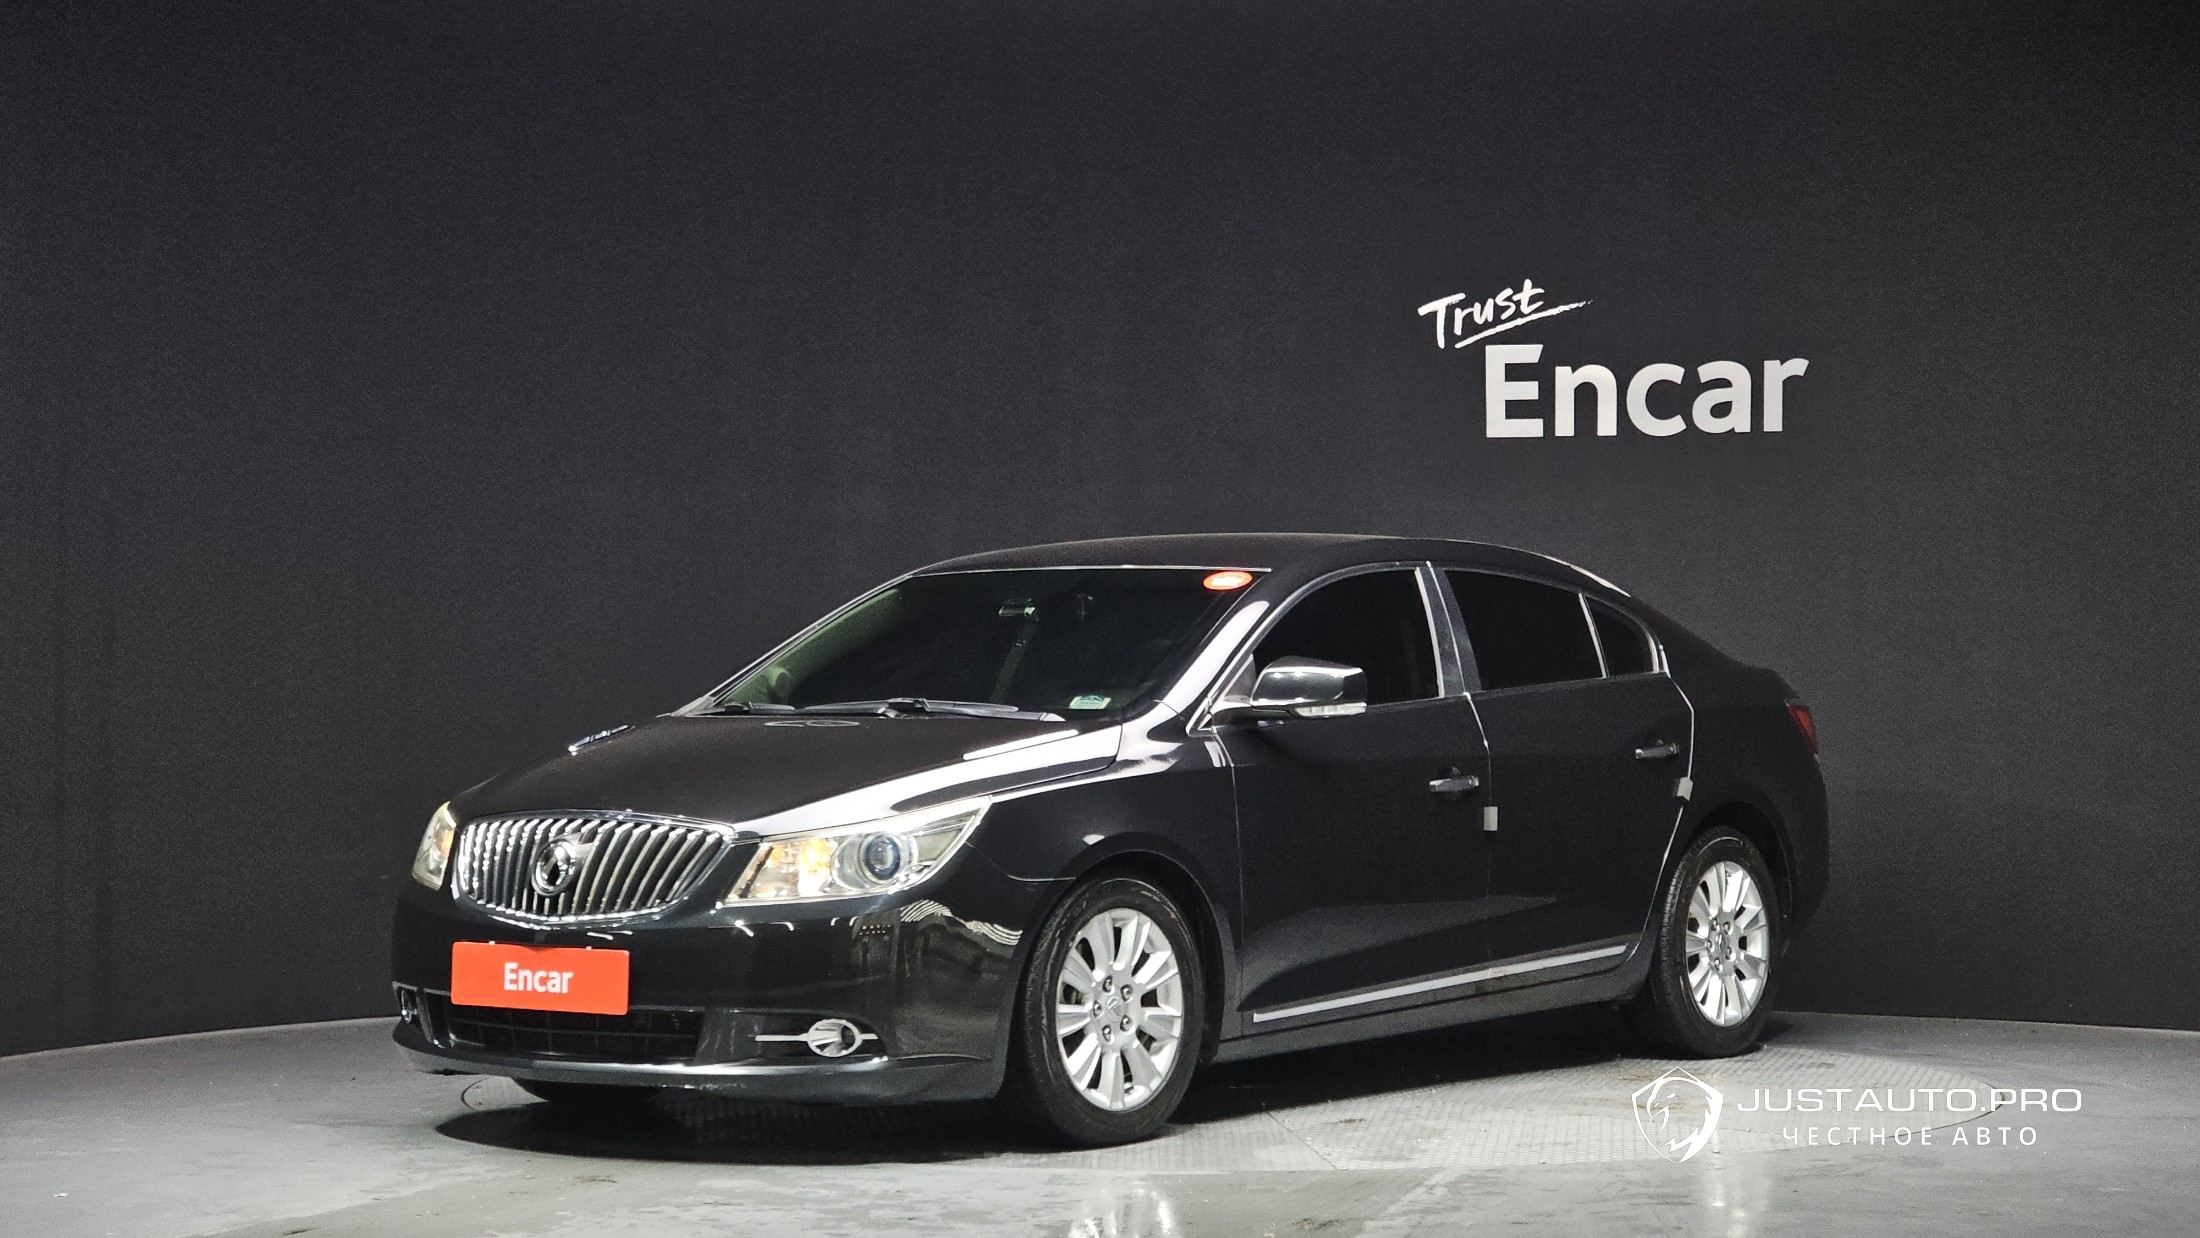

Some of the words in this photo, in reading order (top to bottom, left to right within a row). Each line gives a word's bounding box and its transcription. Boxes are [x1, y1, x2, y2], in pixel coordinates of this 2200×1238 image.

[1417, 278, 1546, 350] Trust
[1485, 343, 1810, 438] Encar
[503, 961, 574, 994] Encar
